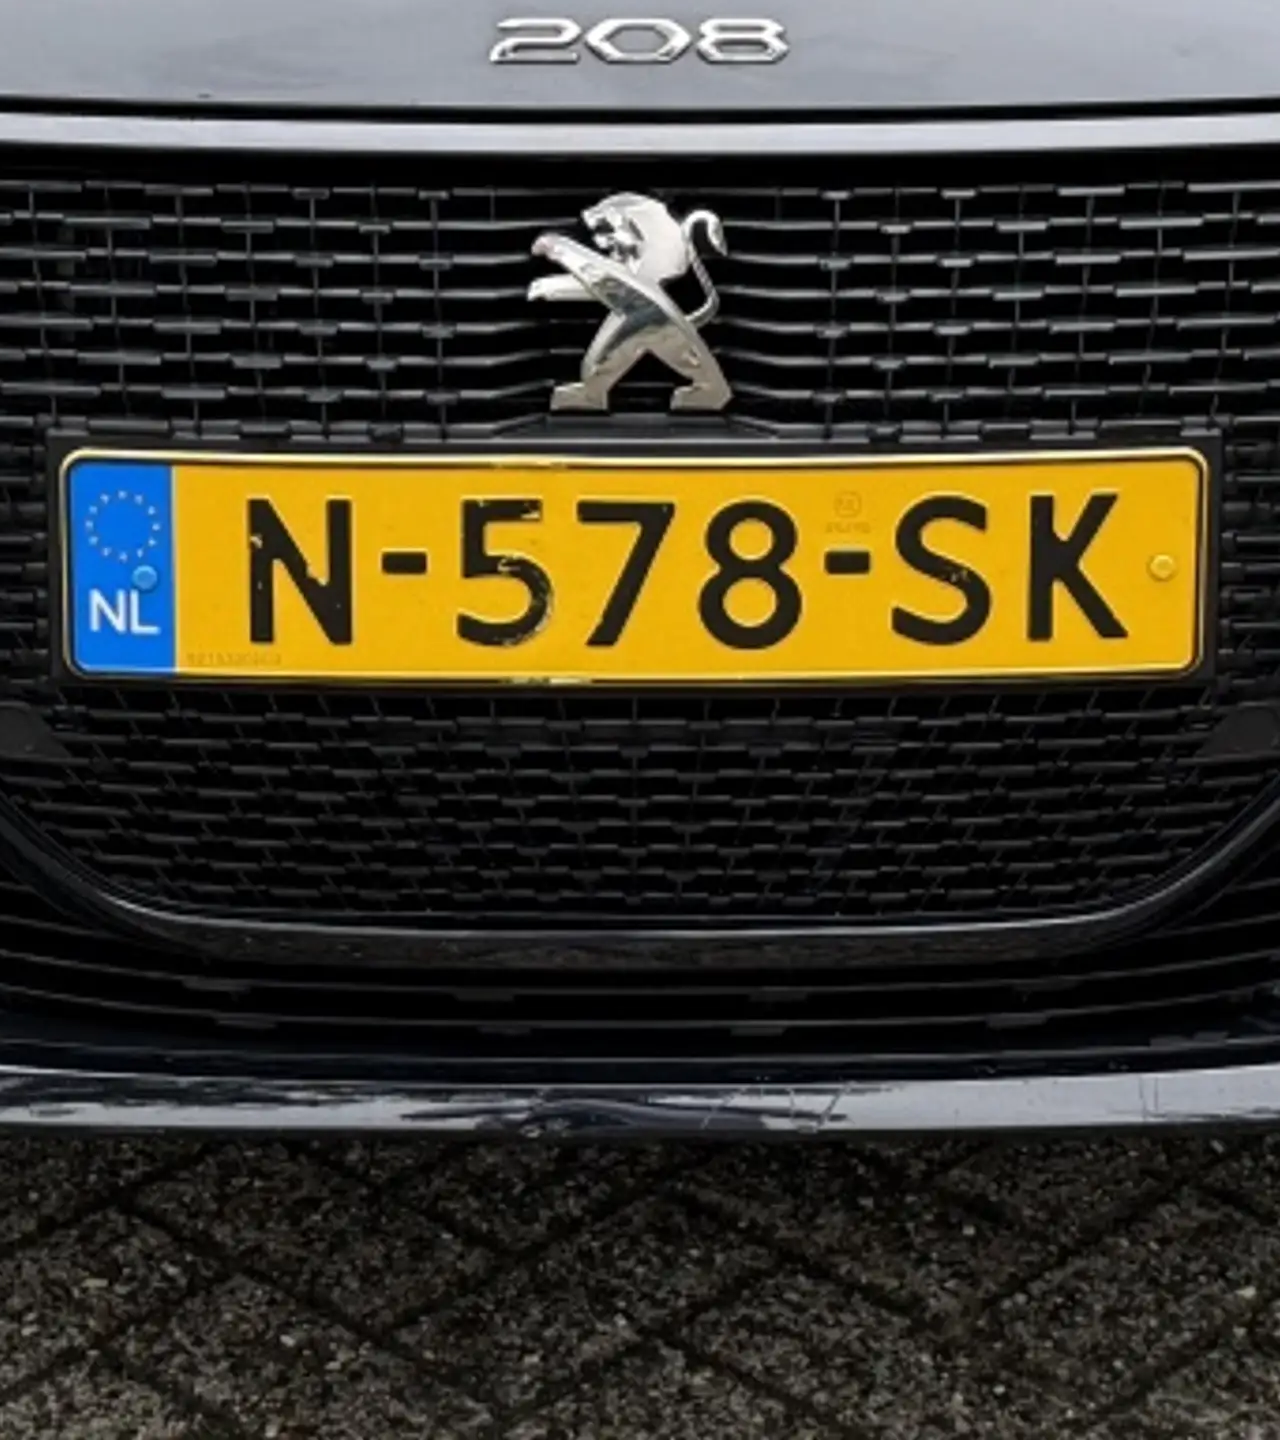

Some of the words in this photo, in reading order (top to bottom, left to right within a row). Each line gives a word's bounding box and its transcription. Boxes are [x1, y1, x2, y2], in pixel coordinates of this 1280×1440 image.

[489, 17, 790, 65] 208
[247, 494, 1129, 651] N-578-SK
[88, 589, 161, 635] NL
